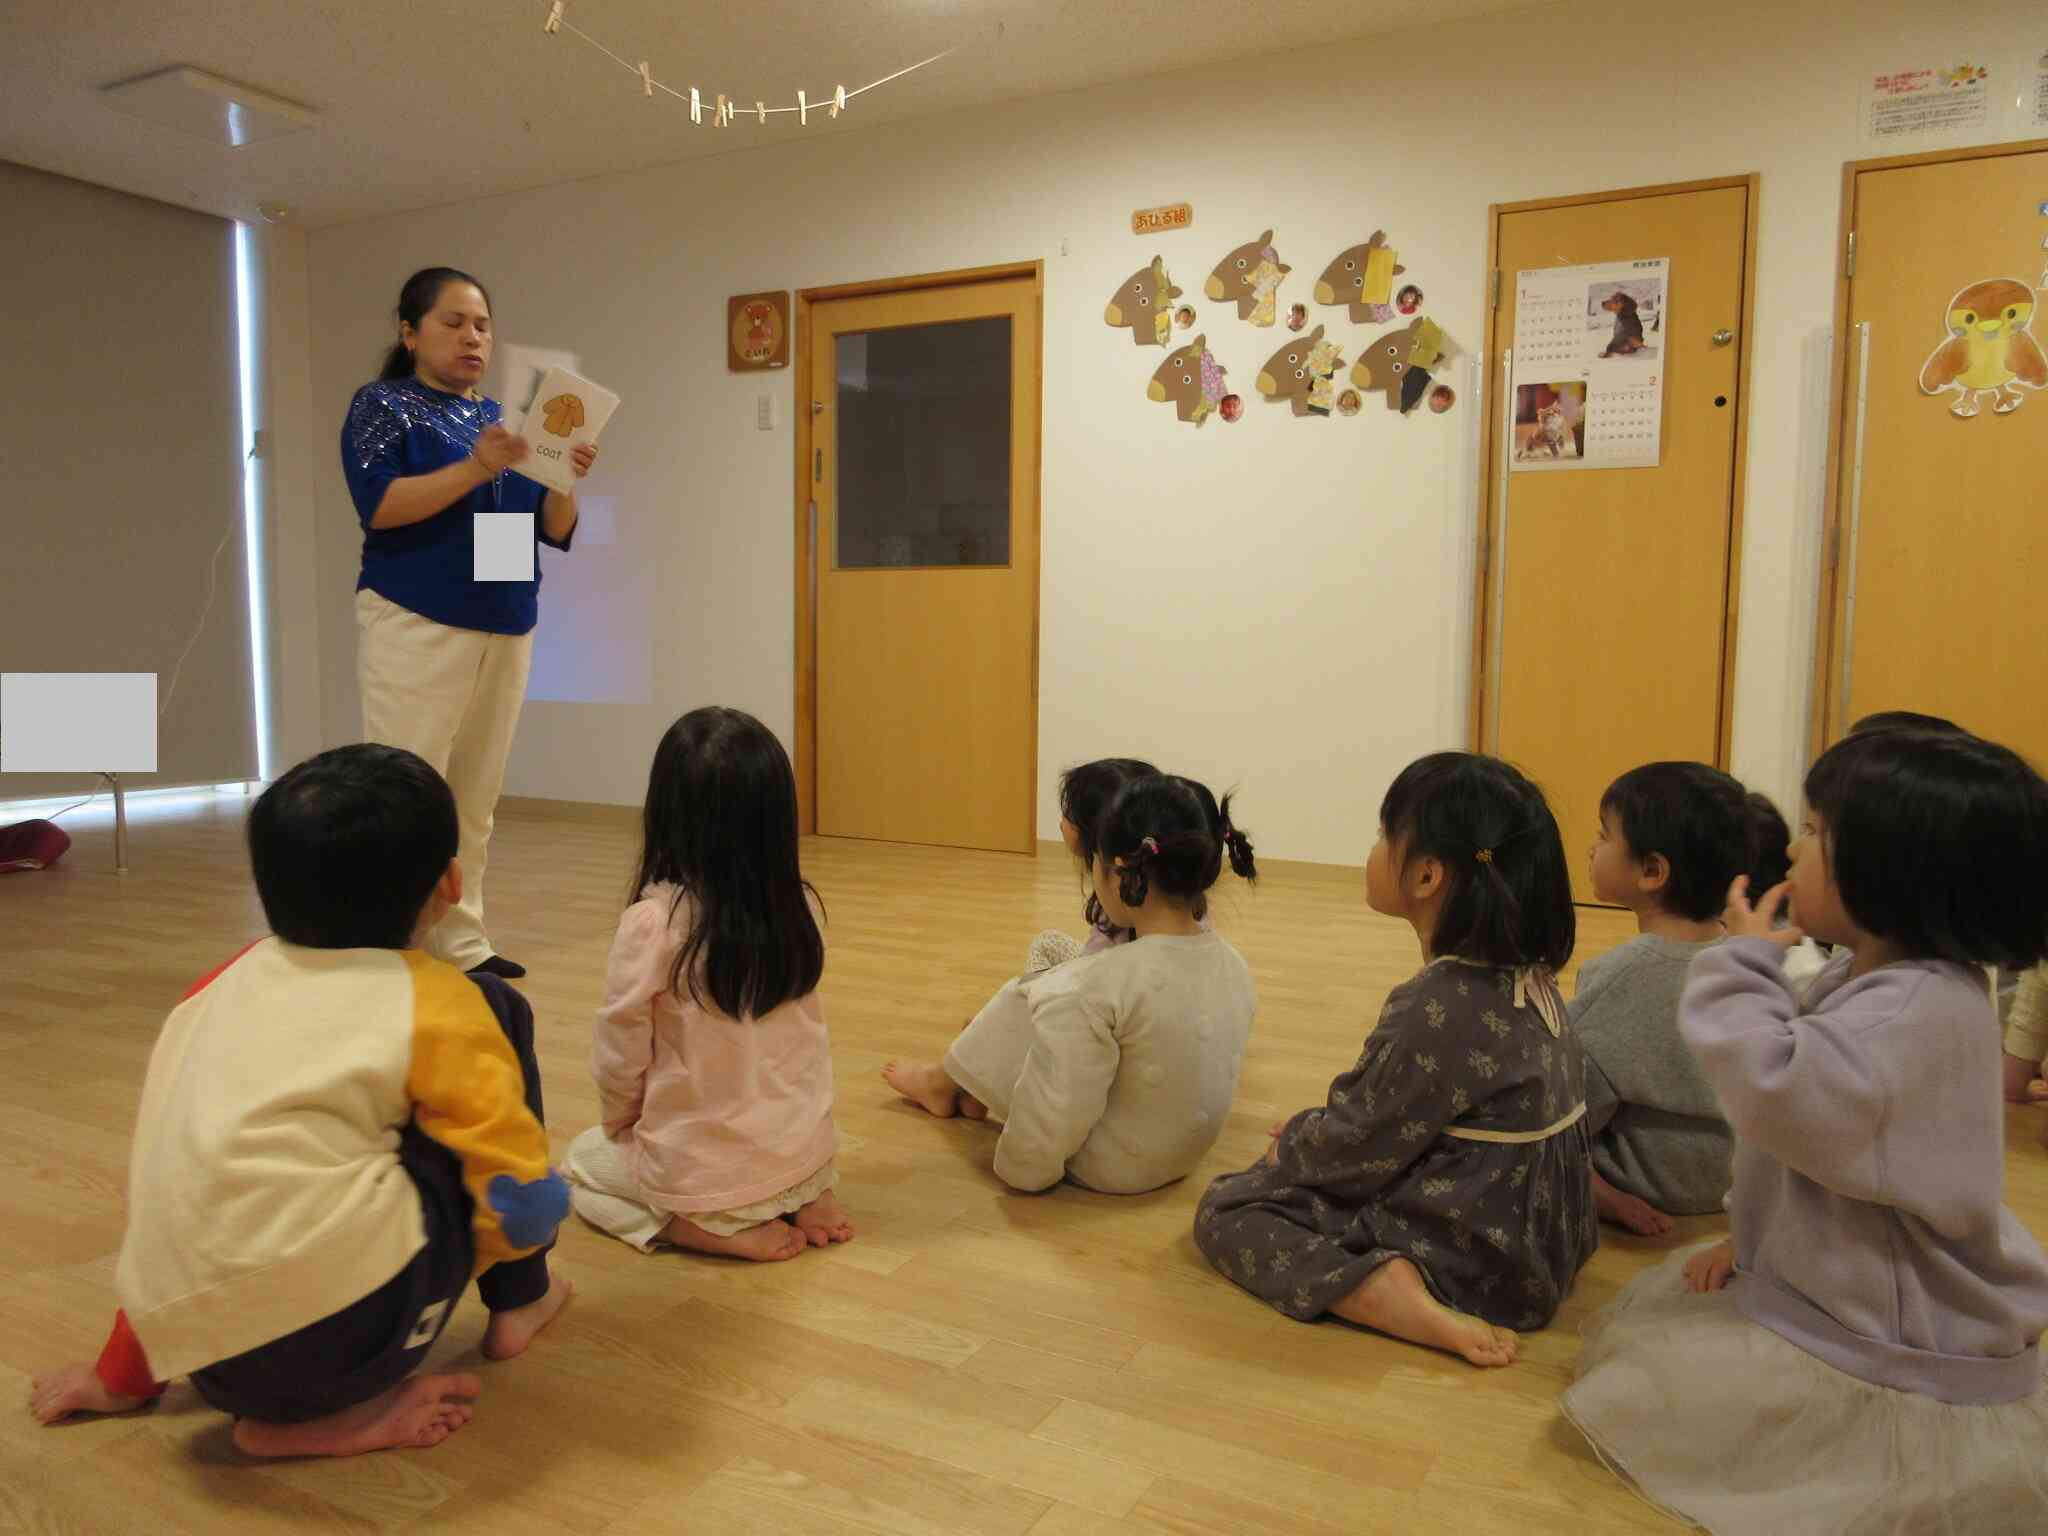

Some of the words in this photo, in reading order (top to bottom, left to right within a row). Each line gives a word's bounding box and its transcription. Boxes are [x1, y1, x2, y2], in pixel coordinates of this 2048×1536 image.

[1135, 207, 1186, 229] あひる組
[536, 445, 562, 461] coat
